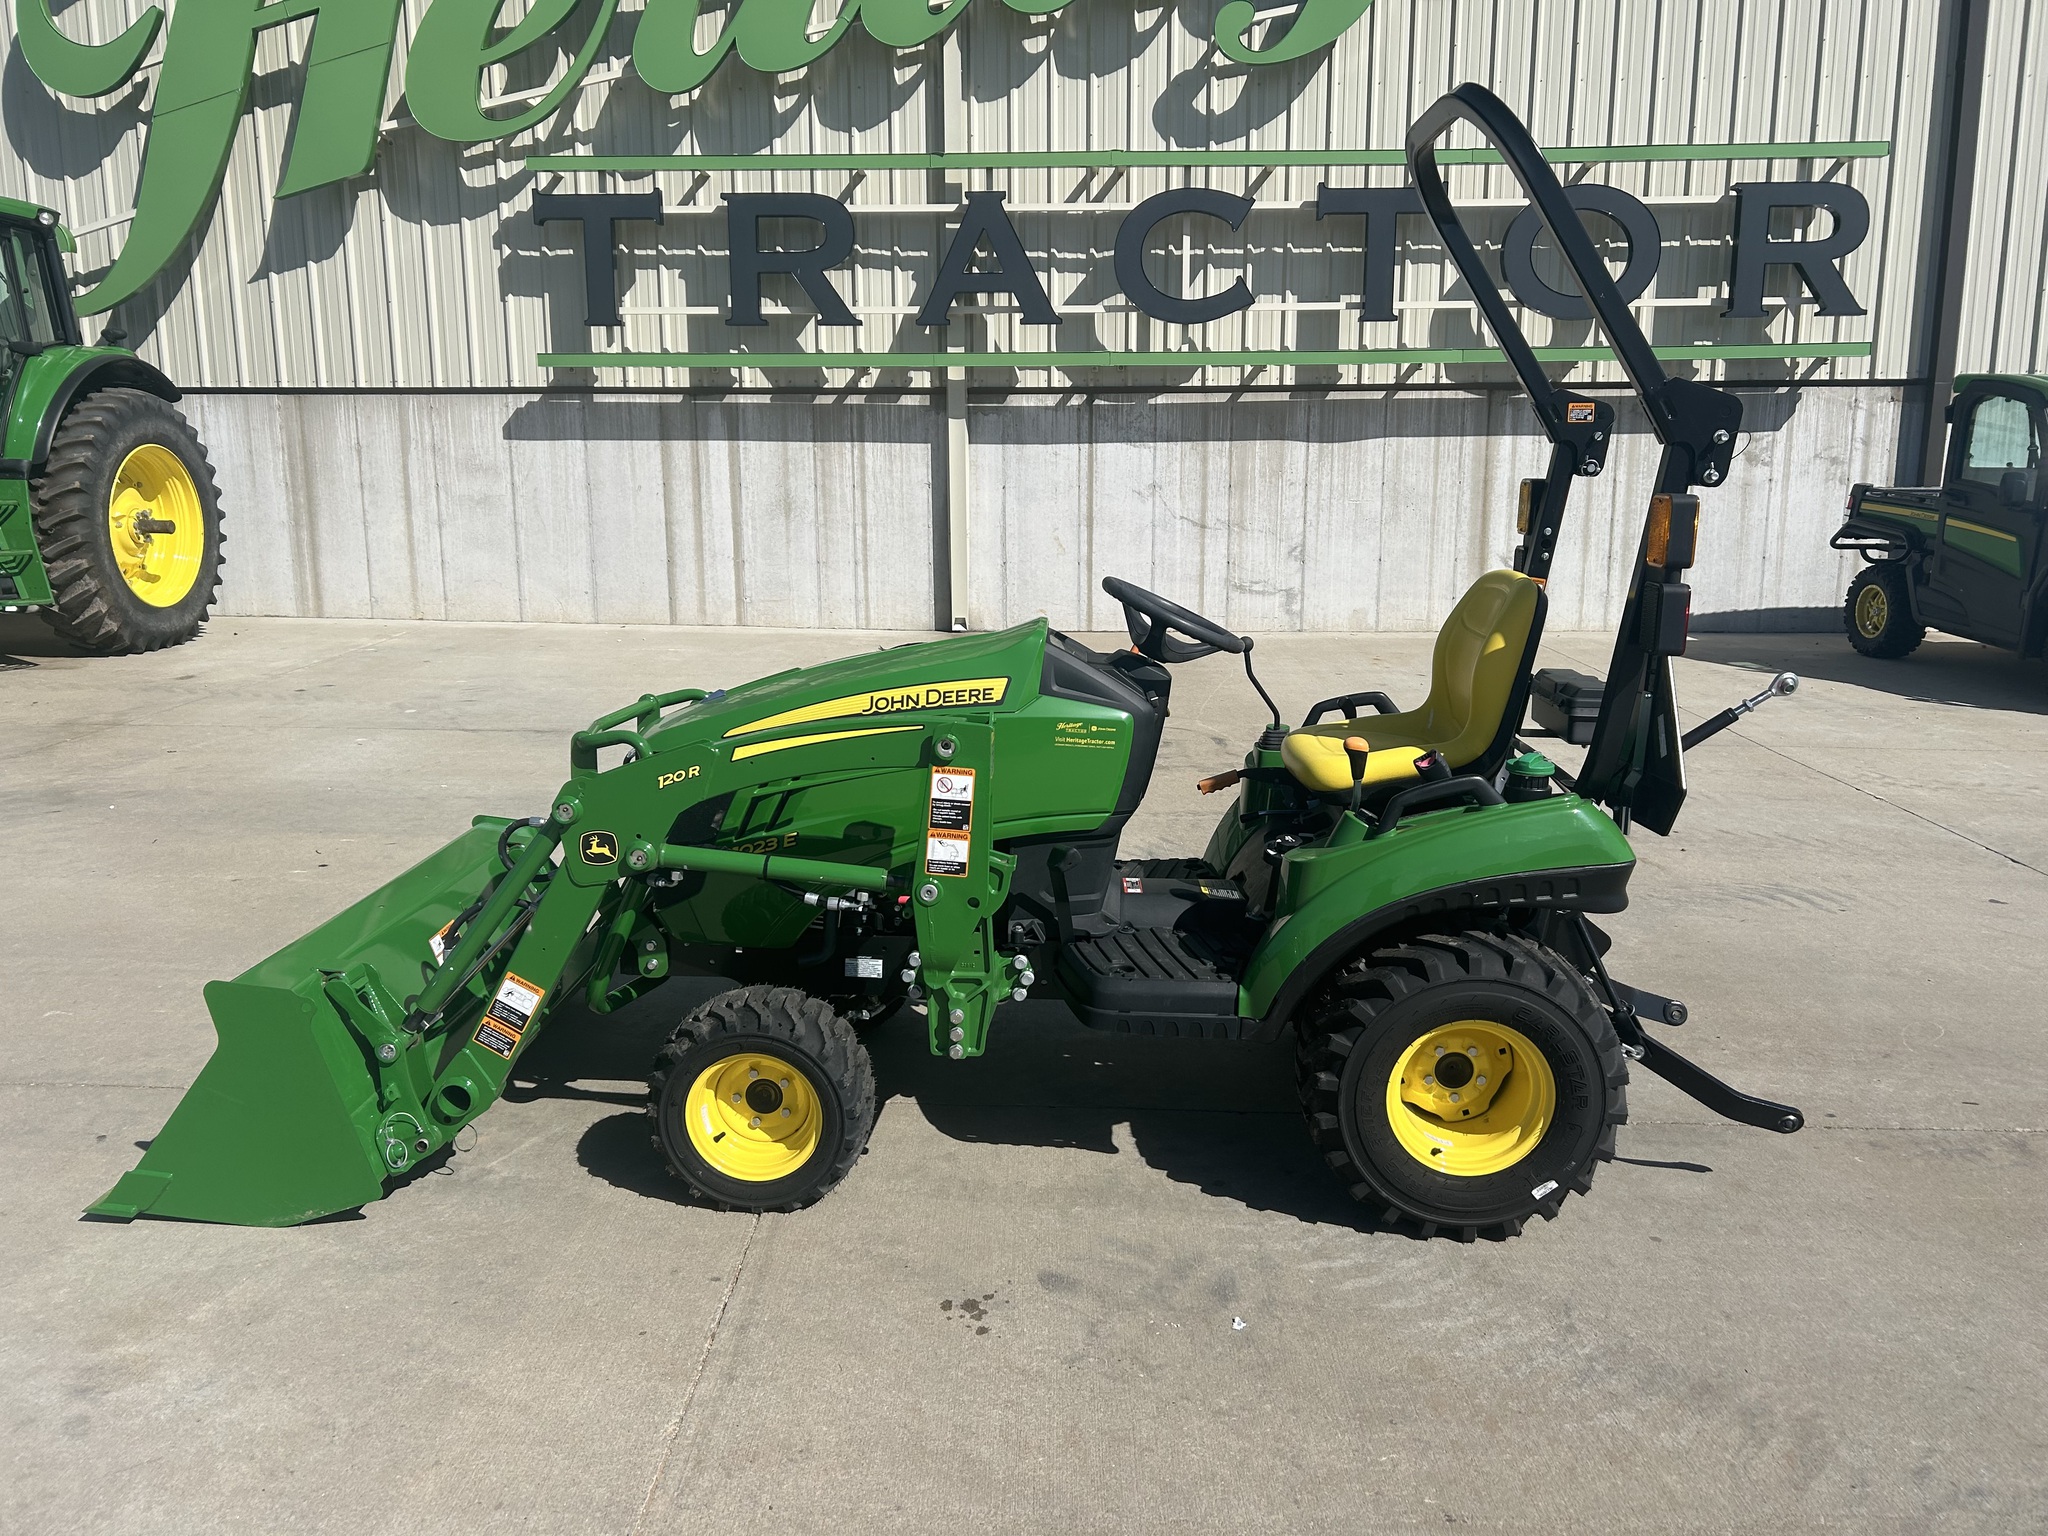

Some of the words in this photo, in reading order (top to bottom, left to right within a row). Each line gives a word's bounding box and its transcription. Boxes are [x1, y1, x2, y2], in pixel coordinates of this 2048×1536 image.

[532, 182, 1870, 327] TRACTOR
[862, 693, 920, 713] JOHN
[925, 688, 995, 706] DEERE
[657, 769, 686, 790] 120
[688, 765, 701, 778] R
[941, 768, 973, 776] WARNING
[783, 831, 798, 848] E
[937, 832, 968, 840] WARNING
[516, 979, 540, 994] WARNING
[493, 1023, 517, 1039] WARNING
